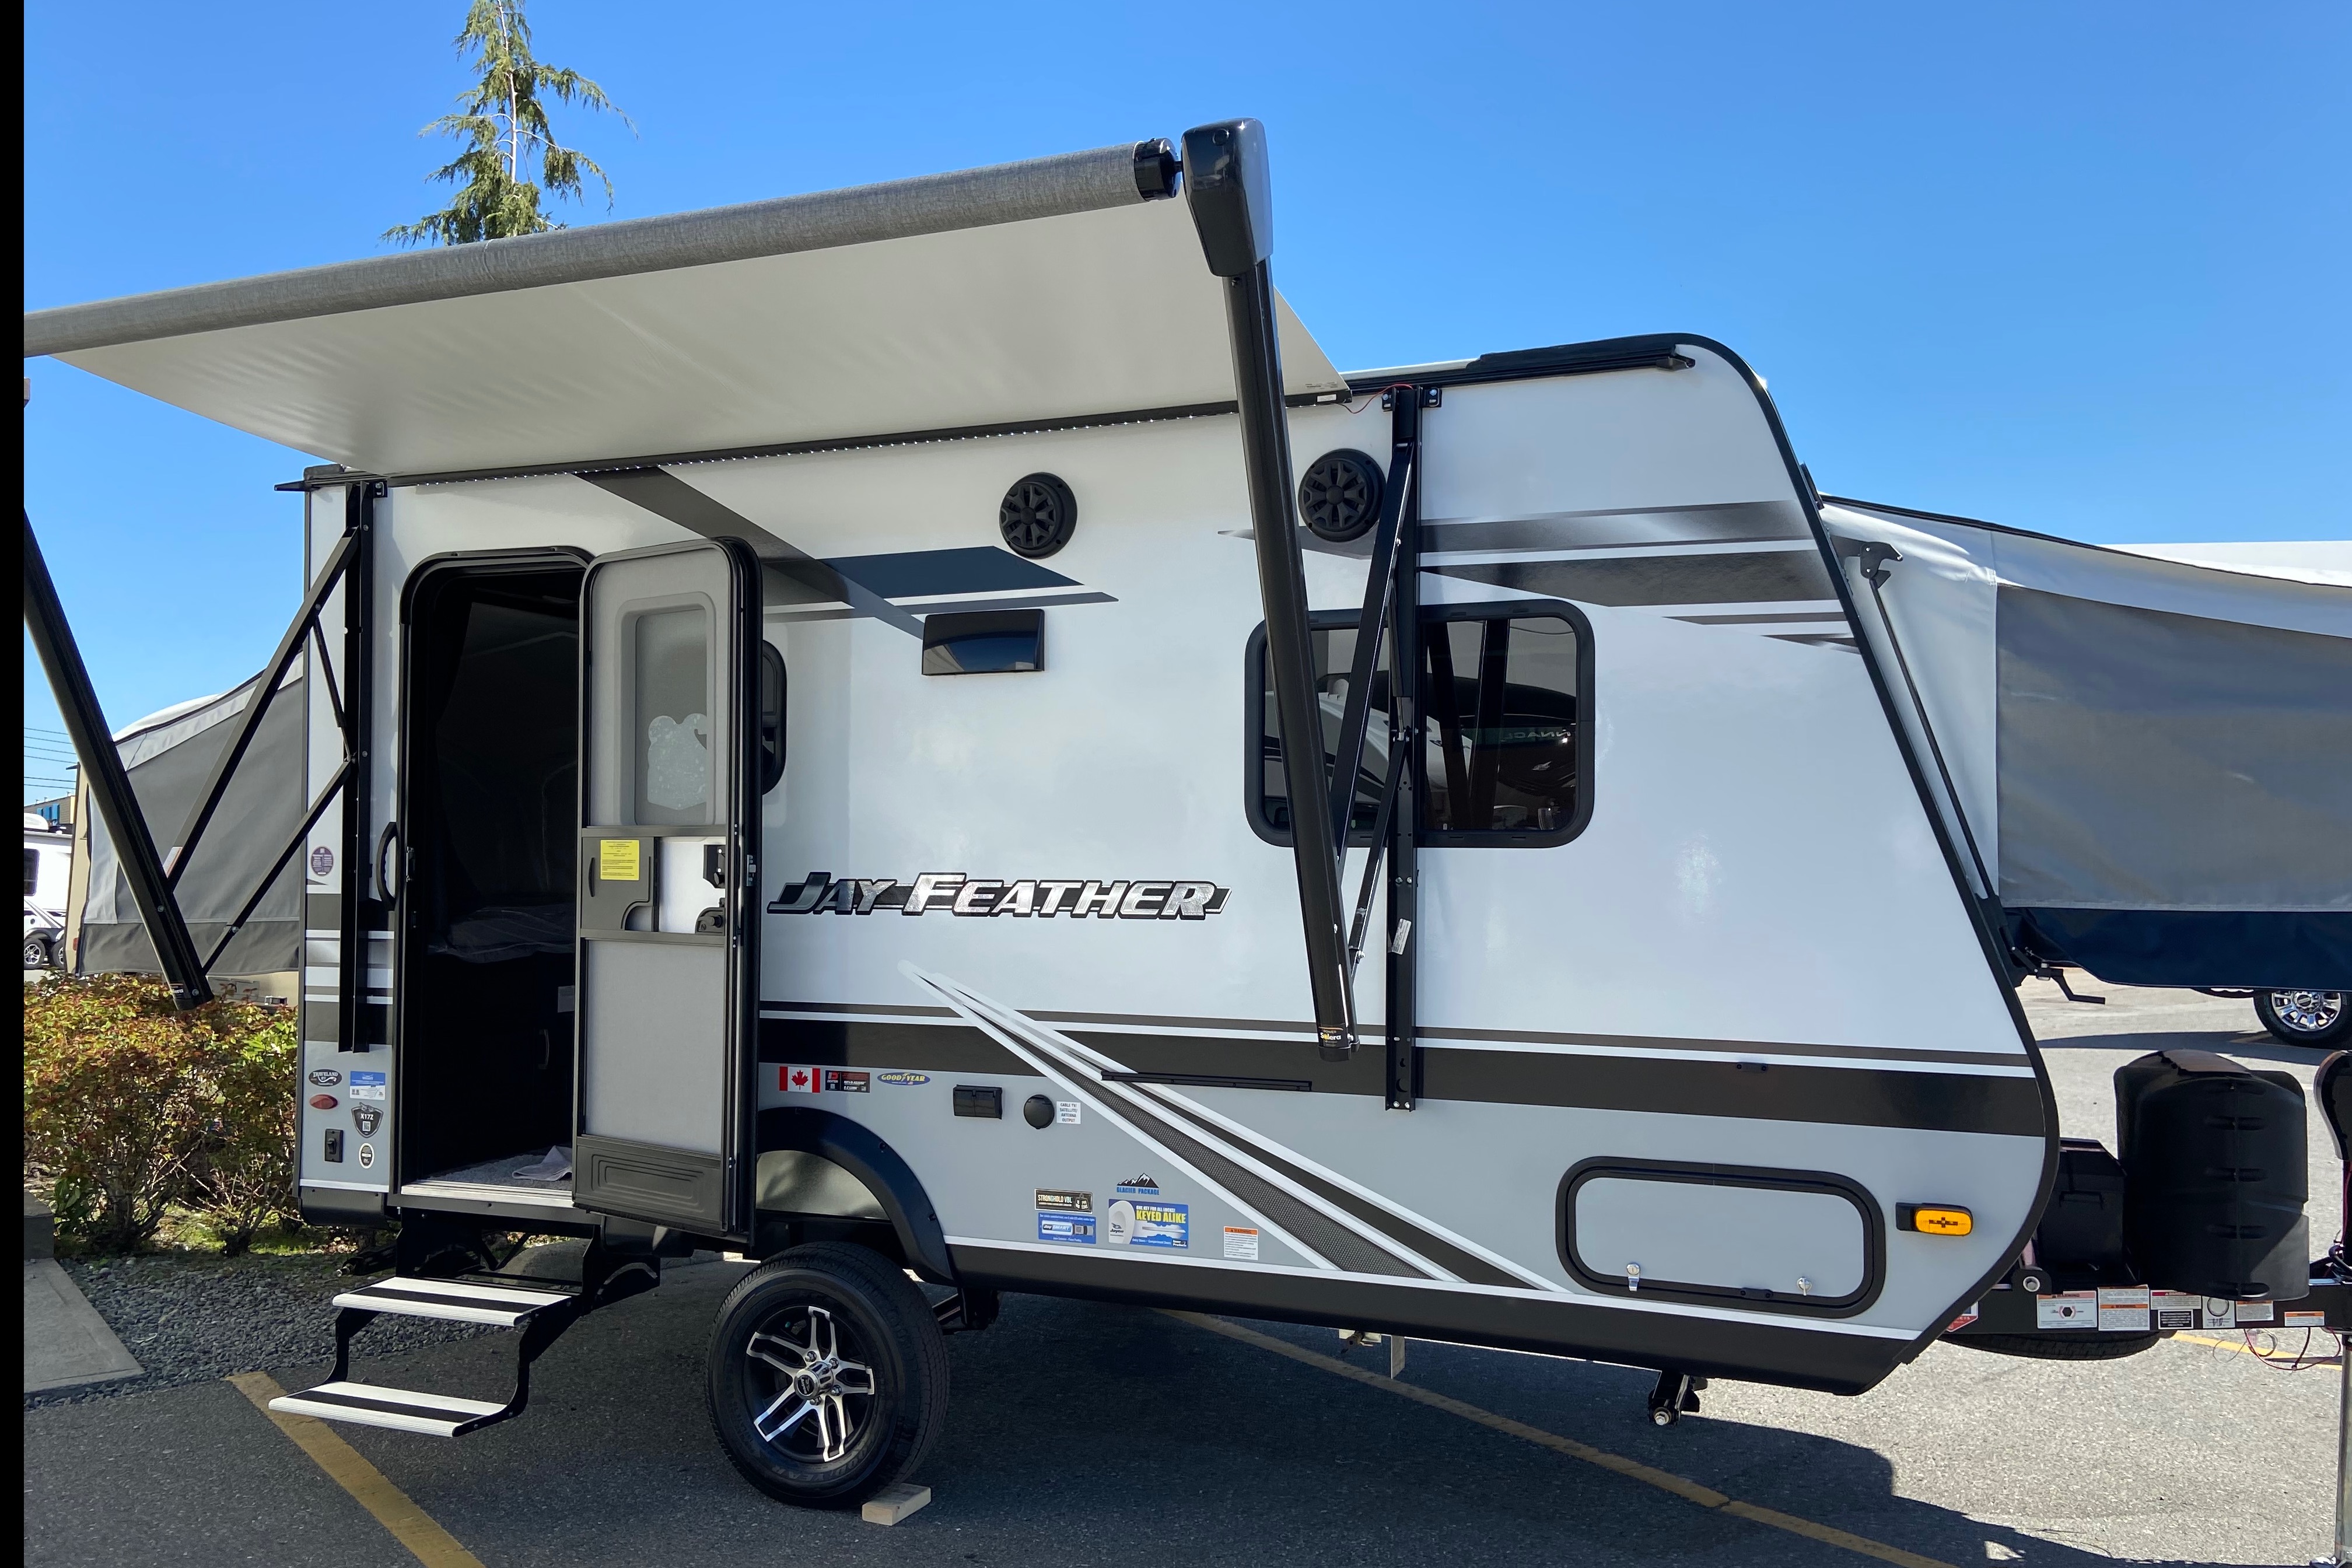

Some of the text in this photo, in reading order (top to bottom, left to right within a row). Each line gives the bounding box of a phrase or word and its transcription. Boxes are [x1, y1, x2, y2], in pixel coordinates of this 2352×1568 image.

[766, 872, 1217, 921] JAY FEATHER
[1038, 1195, 1064, 1203] STRONGHOLD
[1136, 1210, 1186, 1224] KEYED ALIKE
